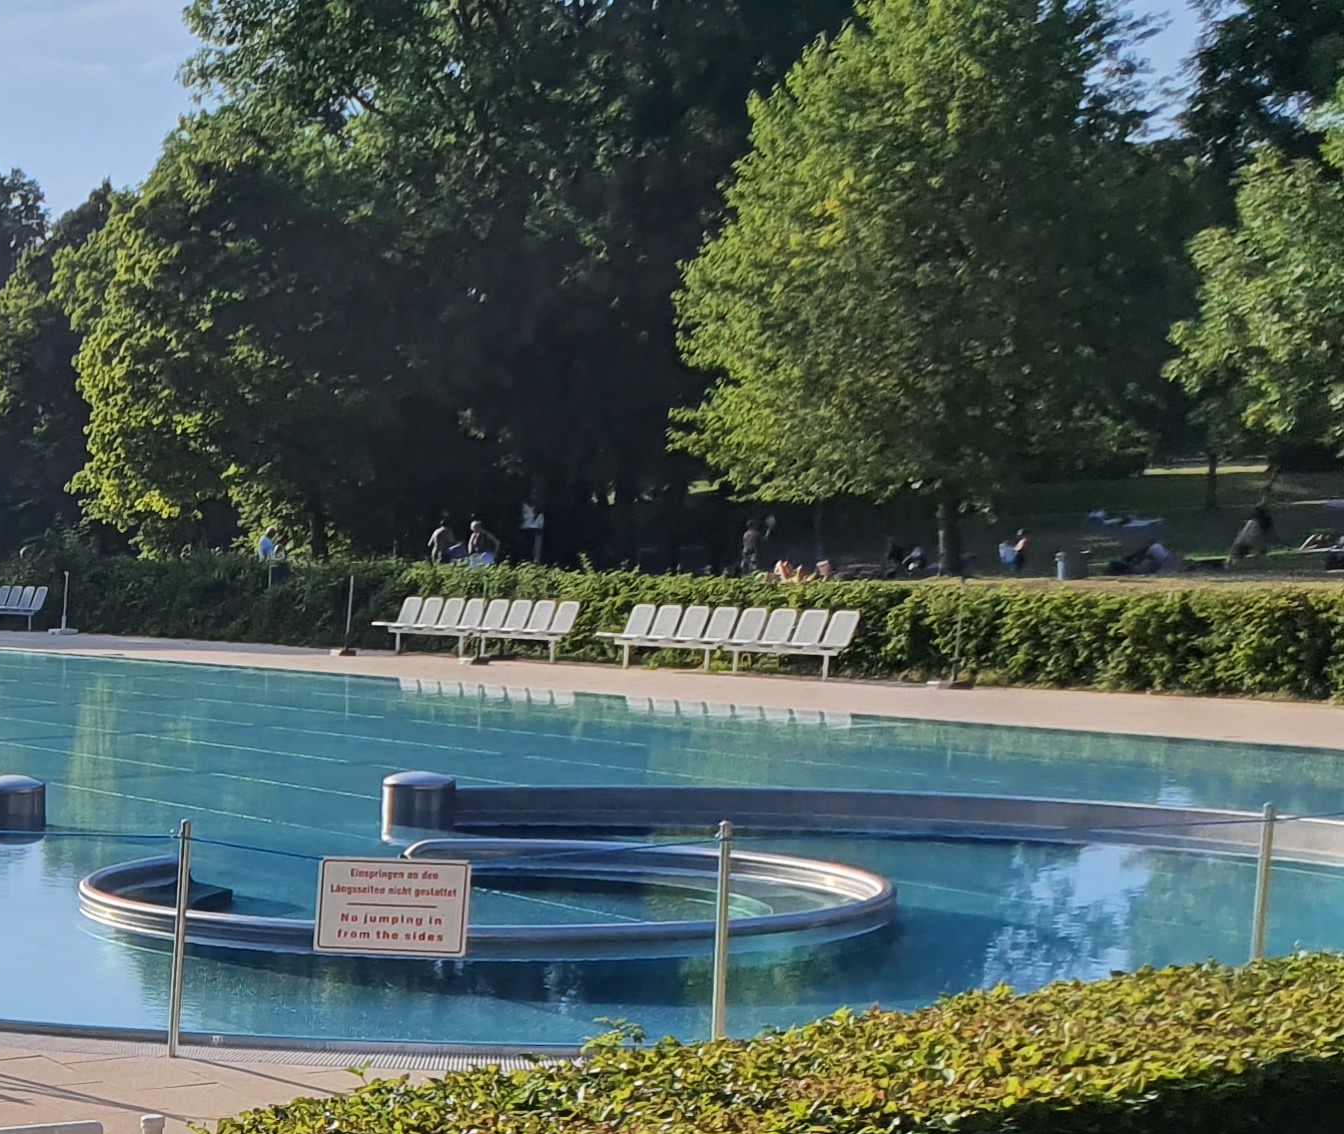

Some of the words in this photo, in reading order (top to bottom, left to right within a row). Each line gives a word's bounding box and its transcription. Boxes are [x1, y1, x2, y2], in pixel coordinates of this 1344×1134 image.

[350, 868, 404, 880] Einspringen
[407, 871, 419, 880] an
[421, 870, 439, 880] den
[330, 884, 385, 896] Längsseiten
[388, 886, 412, 896] nicht
[414, 887, 457, 898] gestattet
[340, 912, 358, 922] No
[363, 913, 423, 927] jumping
[429, 915, 443, 925] in
[337, 928, 370, 939] from
[376, 930, 399, 940] the
[404, 930, 443, 942] sides
